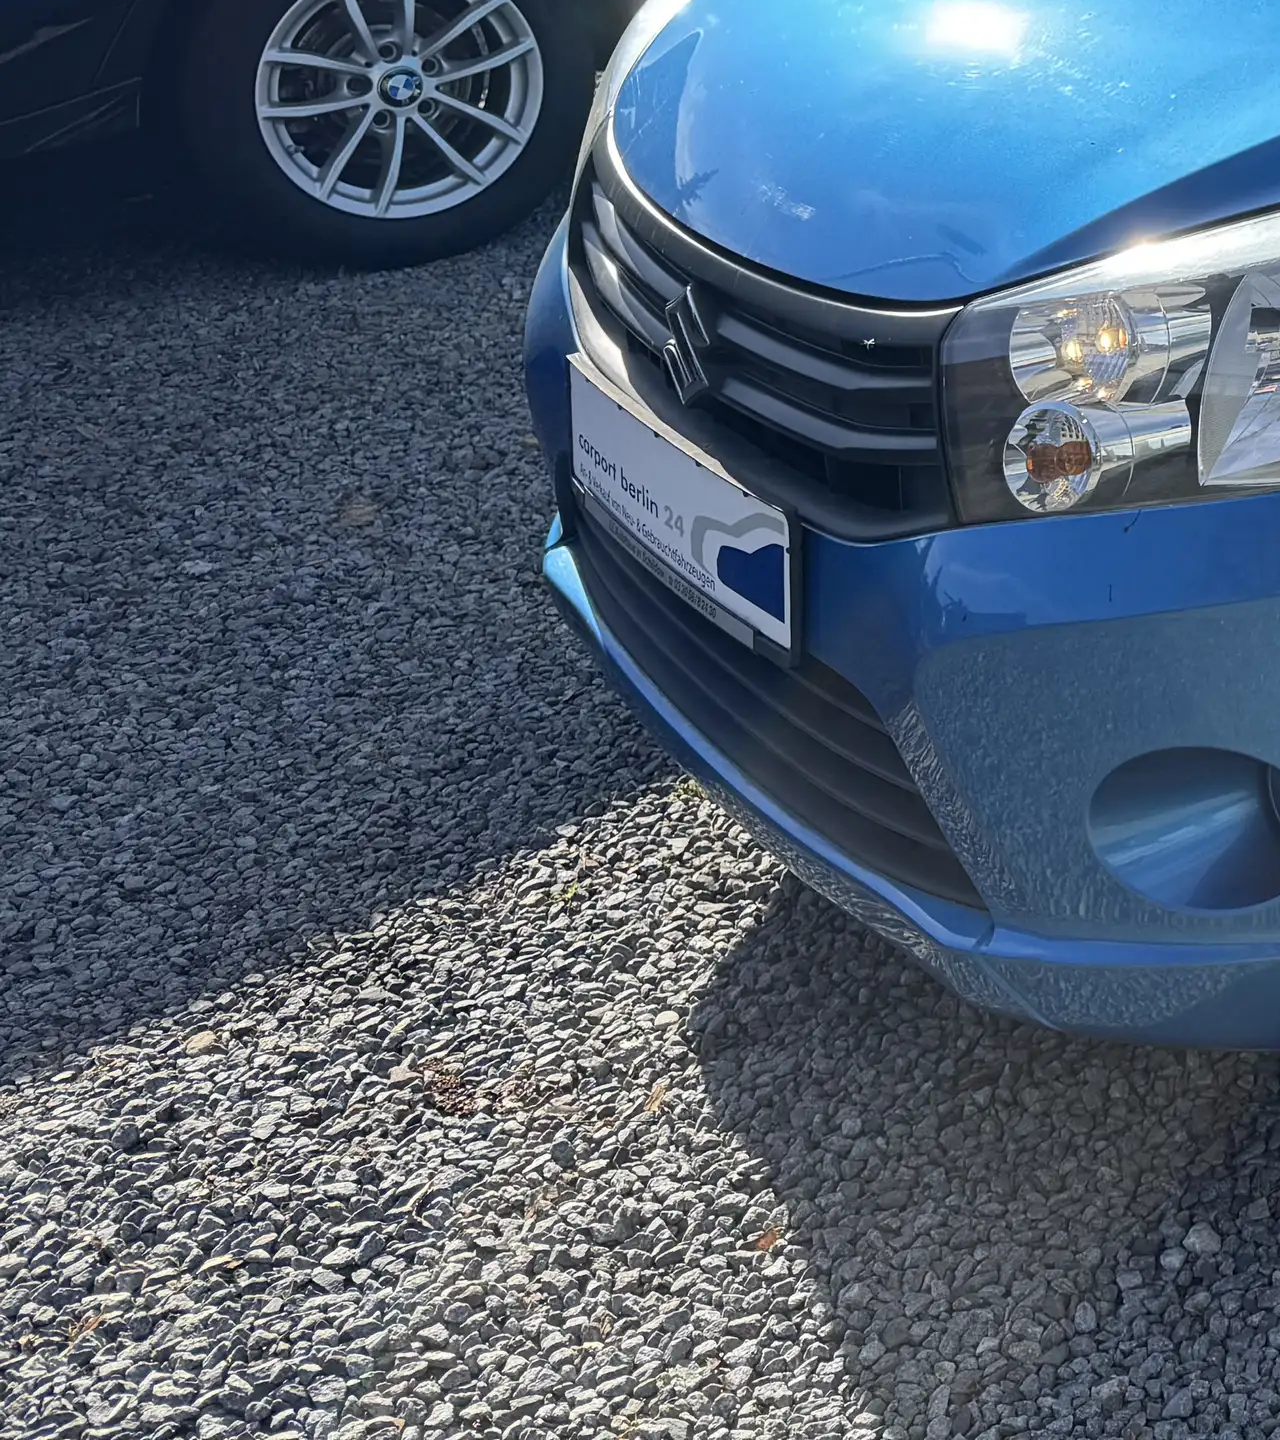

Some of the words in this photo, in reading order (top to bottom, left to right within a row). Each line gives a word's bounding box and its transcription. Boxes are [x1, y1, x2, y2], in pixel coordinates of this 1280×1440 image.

[578, 433, 617, 482] carport
[620, 466, 659, 519] berlin
[664, 505, 685, 538] 24
[641, 523, 716, 592] Gebrauchtfahrzeugen
